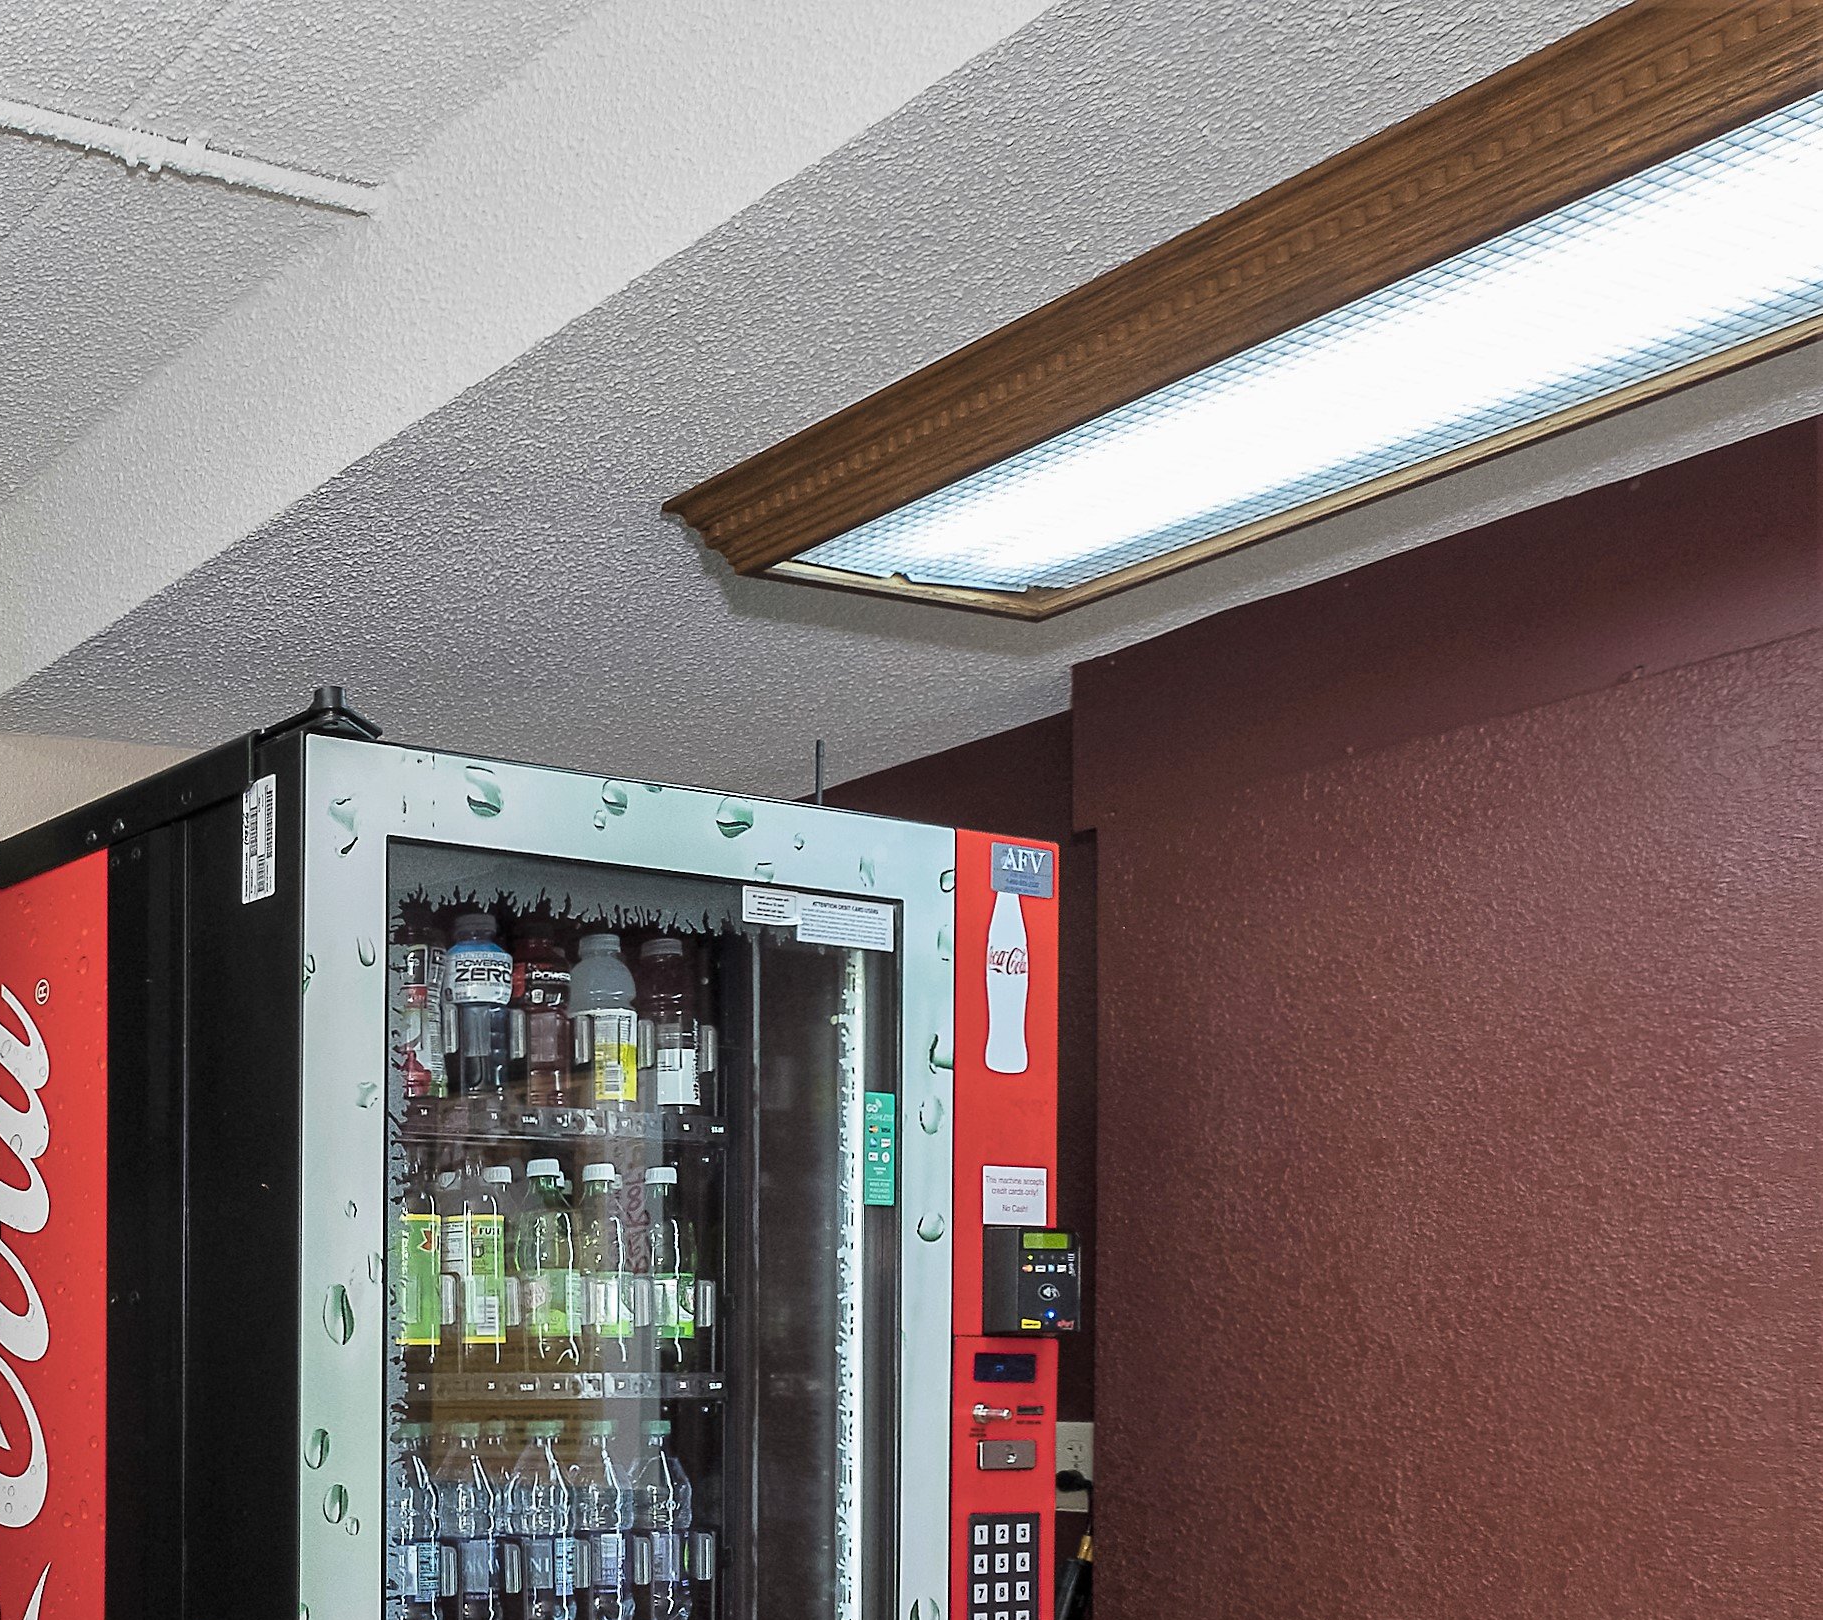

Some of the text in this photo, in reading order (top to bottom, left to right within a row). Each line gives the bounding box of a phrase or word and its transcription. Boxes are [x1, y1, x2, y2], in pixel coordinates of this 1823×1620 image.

[1001, 847, 1047, 874] AFV
[455, 968, 511, 983] ZERO
[979, 1530, 983, 1540] 1
[1000, 1529, 1006, 1539] 2
[978, 1559, 985, 1569] 4
[1000, 1558, 1005, 1568] 5
[1020, 1558, 1026, 1567] 6
[978, 1588, 985, 1599] 7
[999, 1587, 1005, 1597] 8
[1020, 1586, 1026, 1596] 9
